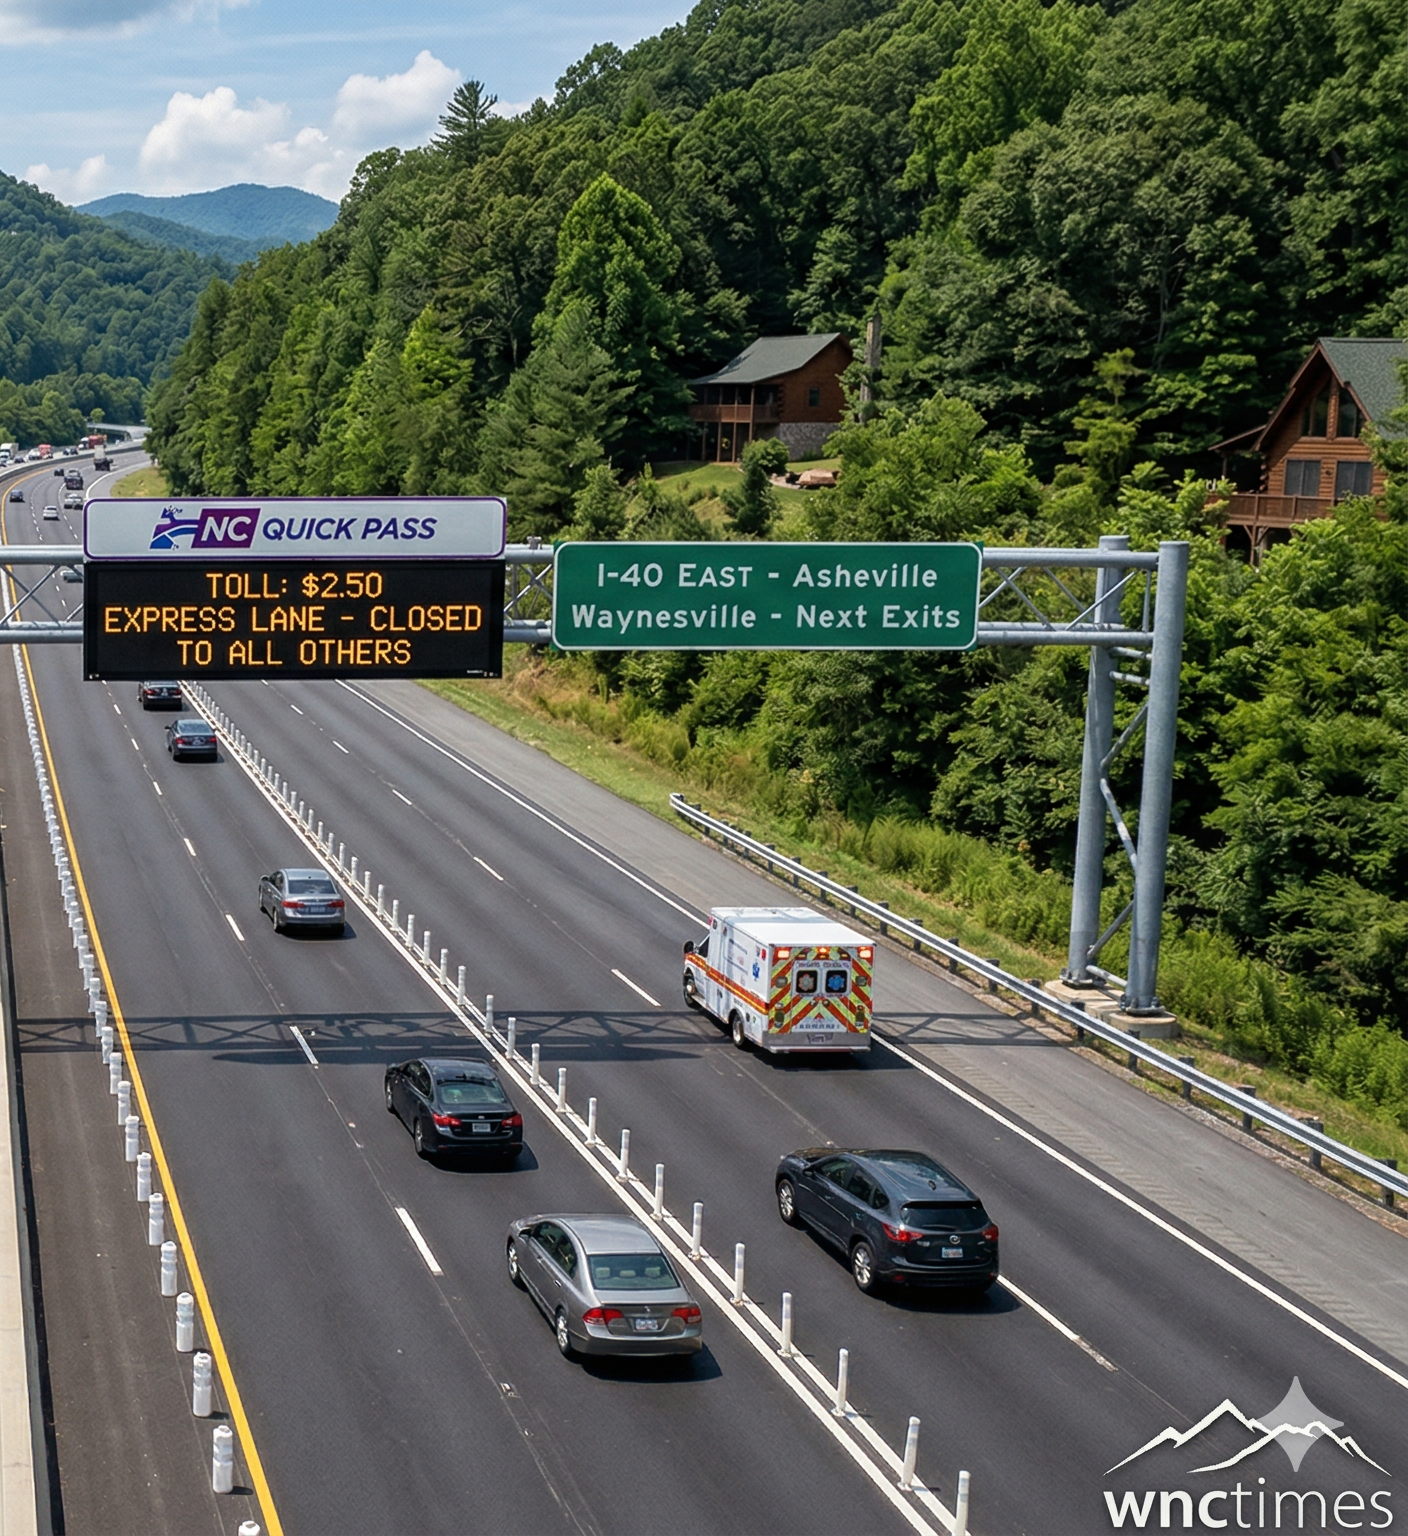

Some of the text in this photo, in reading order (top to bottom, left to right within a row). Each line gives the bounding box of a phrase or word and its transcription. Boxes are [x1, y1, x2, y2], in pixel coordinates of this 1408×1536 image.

[201, 516, 437, 542] NC QUICK PASS
[205, 571, 383, 599] TOLL: $2.50
[598, 562, 663, 588] I-40
[678, 563, 753, 588] EAST
[792, 563, 938, 588] Asheville
[104, 606, 236, 632] EXPRESS
[251, 605, 325, 632] LANE
[370, 605, 482, 632] CLOSED
[571, 604, 756, 634] Waynesville
[797, 604, 867, 628] Next
[882, 604, 961, 628] Exits
[176, 639, 412, 666] TO ALL OTHERS
